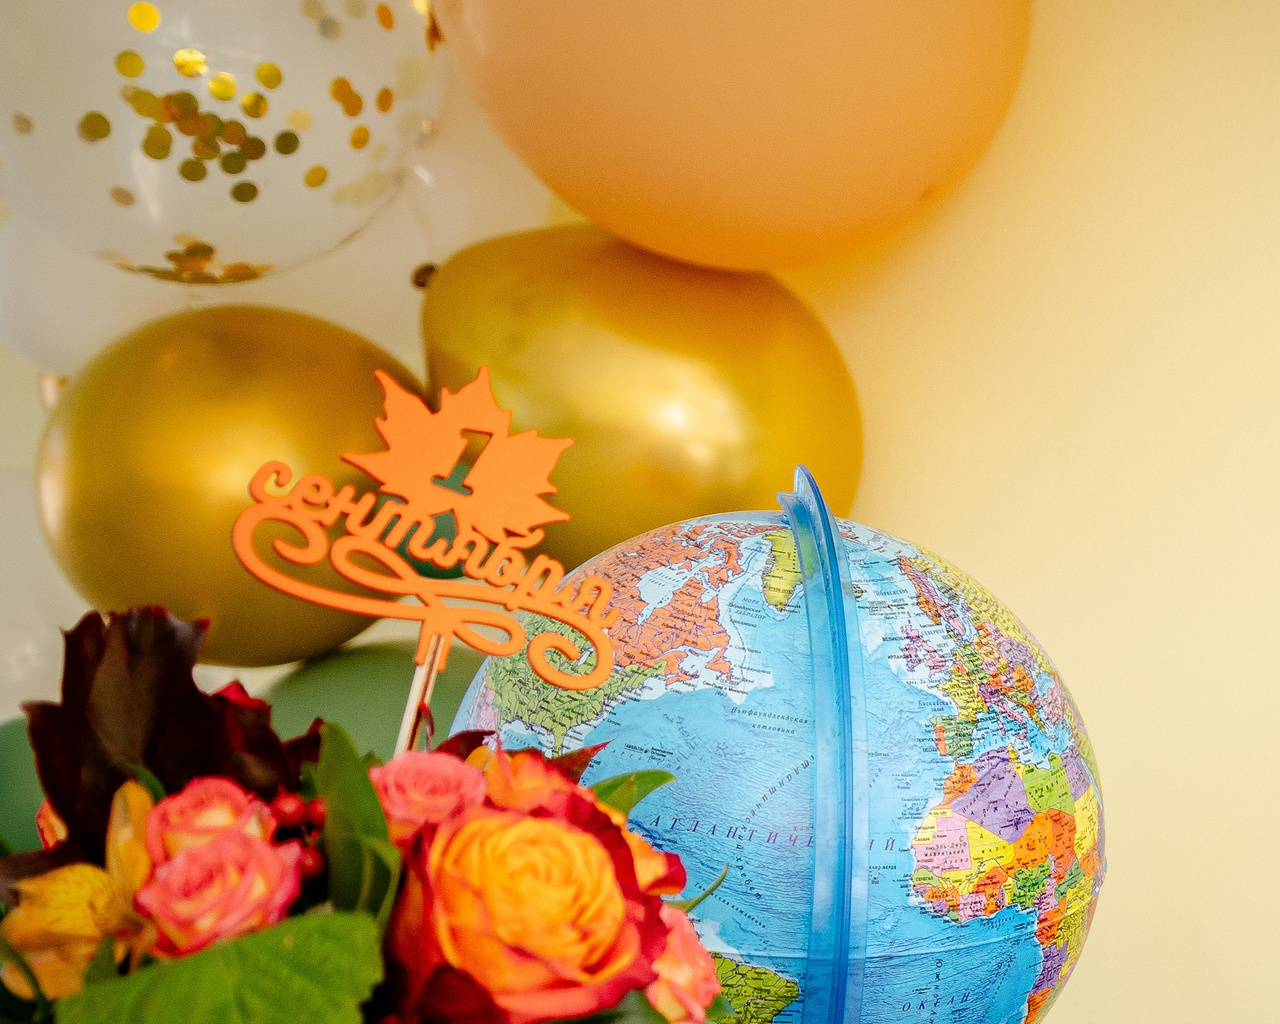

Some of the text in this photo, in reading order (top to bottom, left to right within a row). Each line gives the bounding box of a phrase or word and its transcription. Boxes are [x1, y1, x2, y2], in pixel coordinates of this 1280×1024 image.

[432, 428, 494, 496] 1
[730, 706, 808, 725] Ньюфаундлендская
[751, 723, 796, 735] котловина
[901, 990, 971, 1013] ОКЕАН
